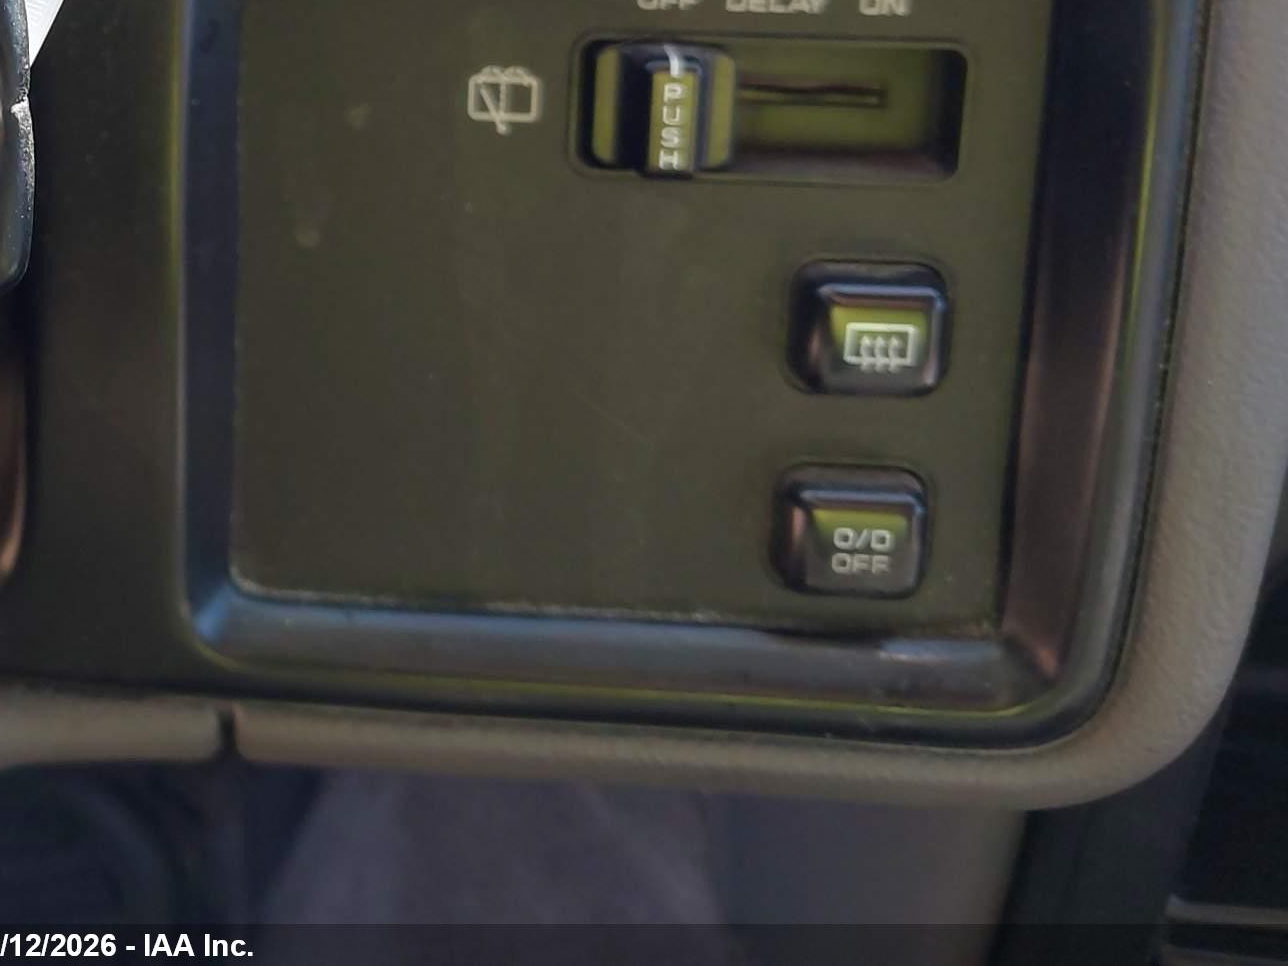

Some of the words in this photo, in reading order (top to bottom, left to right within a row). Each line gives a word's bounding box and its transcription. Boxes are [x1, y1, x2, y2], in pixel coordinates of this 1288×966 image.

[658, 83, 685, 170] PUSH
[833, 527, 894, 552] O/D
[831, 553, 890, 574] OFF
